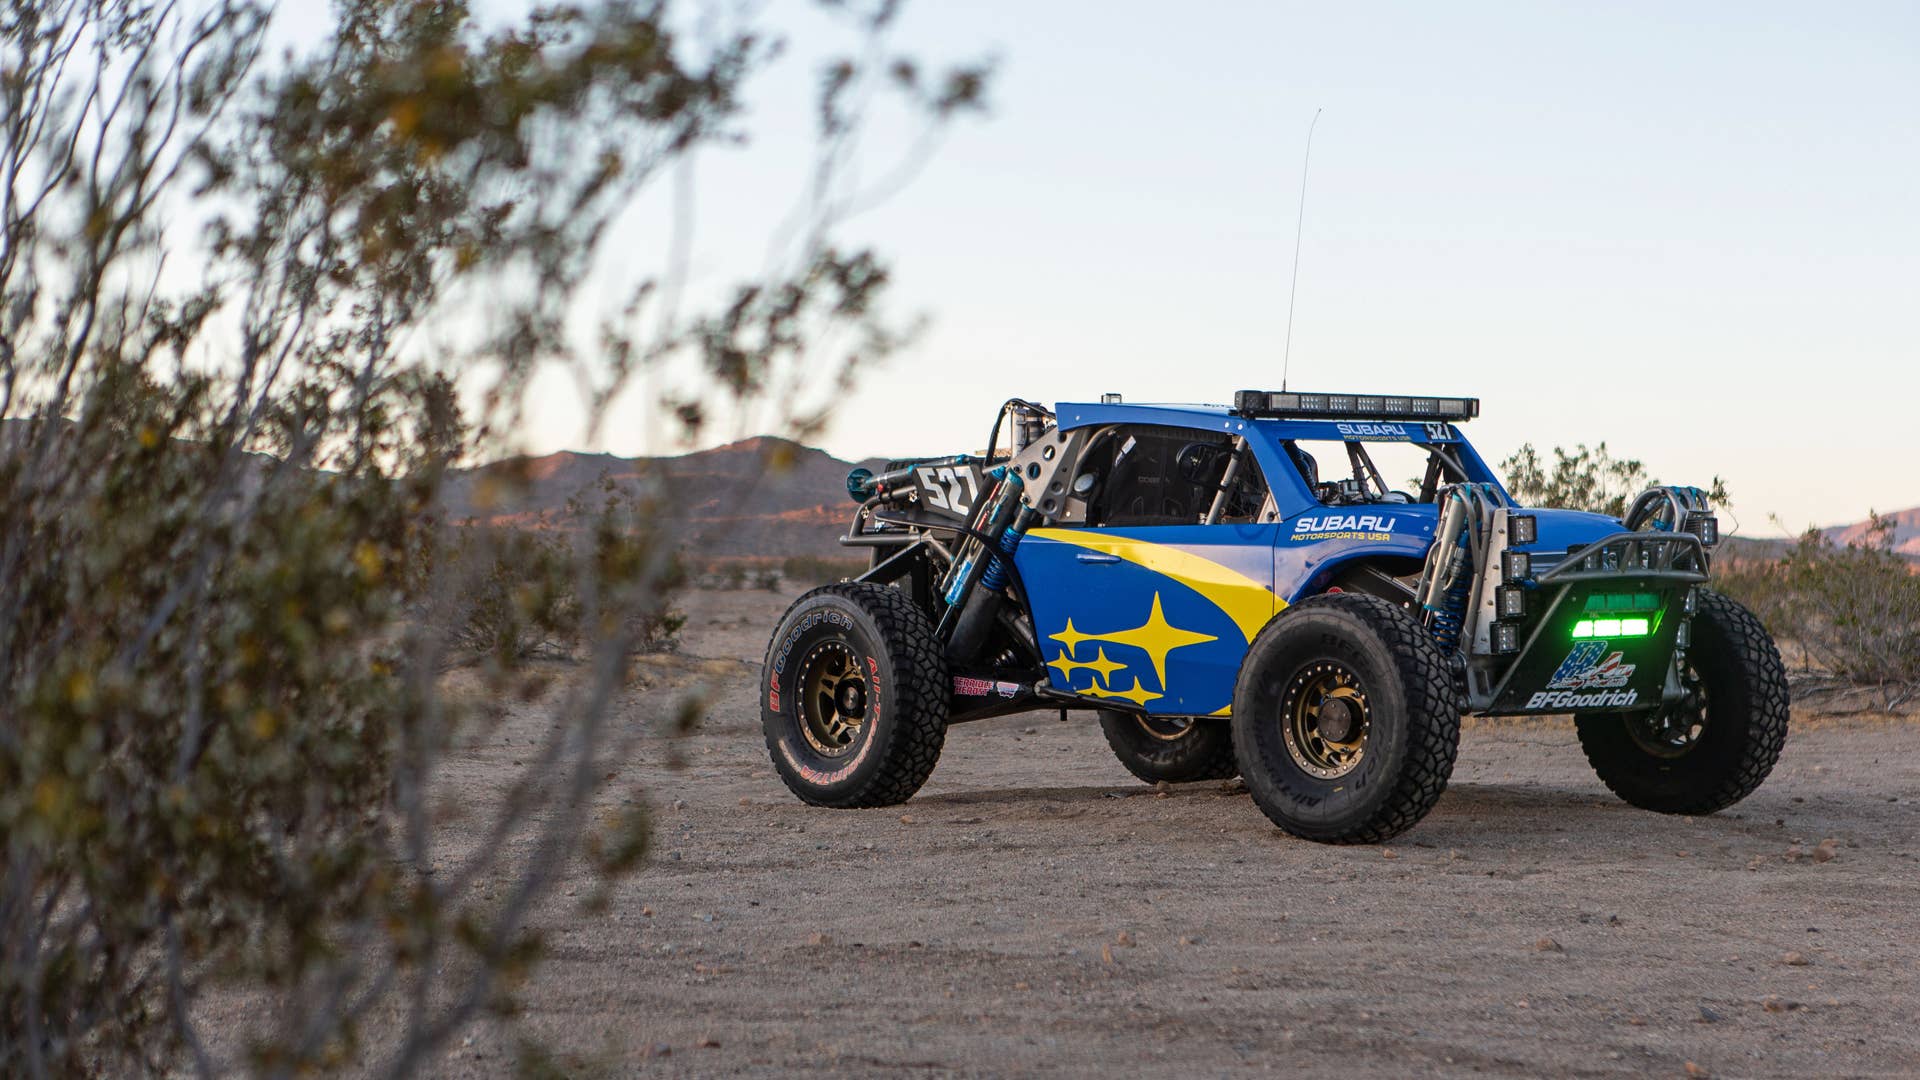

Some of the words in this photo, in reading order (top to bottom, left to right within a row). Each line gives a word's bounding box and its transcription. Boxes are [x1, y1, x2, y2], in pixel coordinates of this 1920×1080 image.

[1336, 424, 1407, 436] SUBARU
[1425, 422, 1453, 440] 527
[916, 465, 979, 516] 527
[1295, 515, 1397, 532] SUBARU
[1291, 532, 1365, 541] MOTORSPORTS
[1367, 533, 1391, 541] USA
[770, 610, 854, 712] BFGoodrich
[1525, 689, 1639, 709] BFGoodrich
